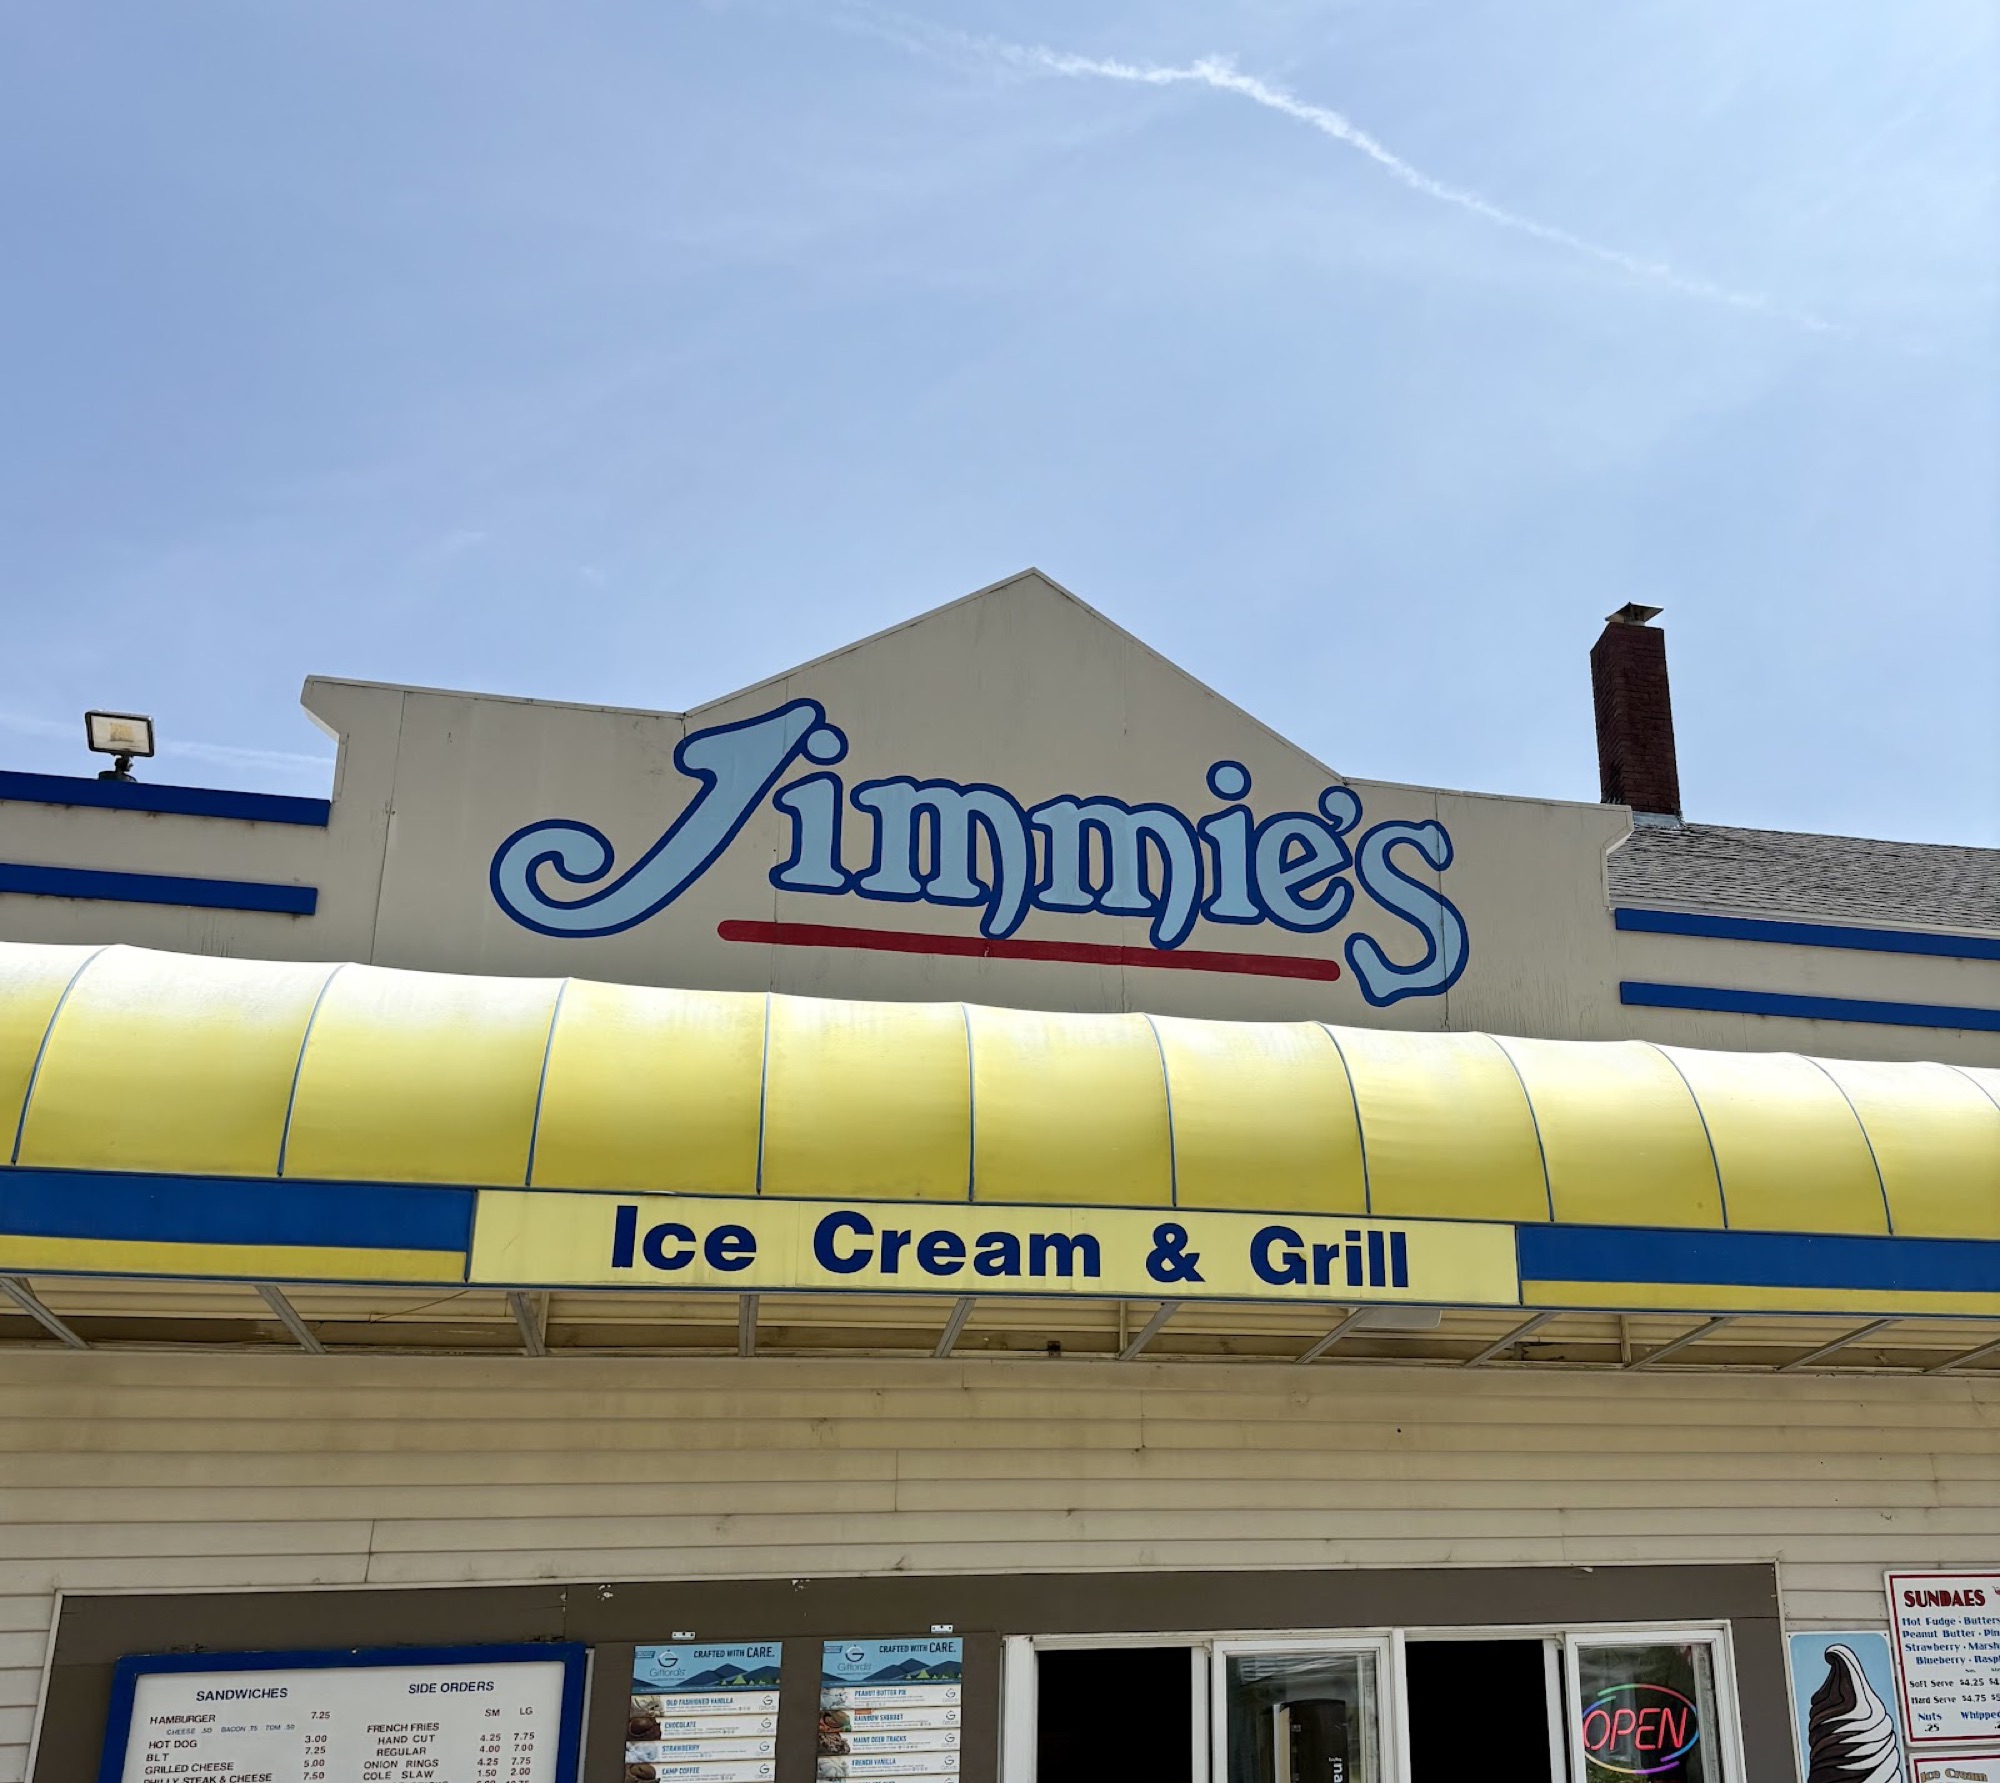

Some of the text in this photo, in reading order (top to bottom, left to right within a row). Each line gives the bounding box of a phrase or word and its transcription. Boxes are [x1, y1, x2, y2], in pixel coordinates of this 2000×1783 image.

[490, 697, 1469, 1007] Jimmie's
[611, 1205, 1409, 1288] Ice Cream & Grill
[1904, 1589, 1986, 1608] SUNDAES
[1902, 1618, 1921, 1626] Hot
[1925, 1617, 1956, 1627] Fudge
[1902, 1630, 1938, 1638] Peanut
[1942, 1630, 1975, 1638] Butter
[693, 1646, 775, 1658] CRAFTED WITH CARE.
[879, 1641, 956, 1653] CRAFTED WITH CARE.
[1905, 1643, 1960, 1652] Strawberry
[1916, 1656, 1966, 1666] Blueberry
[408, 1681, 495, 1694] SIDE ORDERS
[1909, 1680, 1928, 1688] Soft
[1930, 1679, 1954, 1688] Serve
[1959, 1677, 1985, 1687] $4.25
[195, 1687, 289, 1702] SANDWICHES
[1910, 1696, 1931, 1705] Hard
[1933, 1695, 1957, 1704] Serve
[1961, 1694, 1987, 1702] $4.75
[149, 1711, 331, 1725] HAMBURGER 7.25
[484, 1706, 534, 1718] SM LG
[1918, 1712, 1943, 1721] Nuts
[166, 1727, 196, 1736] CHEESE
[220, 1725, 246, 1733] BACON
[366, 1722, 440, 1733] FRENCH FRIES
[664, 1720, 696, 1729] CHOCOLATE
[1582, 1707, 1688, 1751] OPEN
[1924, 1723, 1940, 1732] .25
[148, 1734, 328, 1750] HOT DOG 3.00
[378, 1731, 535, 1745] HAND CUT 4.25 7.75
[305, 1746, 326, 1755] 7.25
[376, 1743, 534, 1757] REGULAR 4.00 7.00
[144, 1759, 326, 1776] GRILLED CHEESE 5.00
[363, 1756, 531, 1770] ONION RINGS 4.25 7.75
[229, 1773, 272, 1783] CHEESE
[303, 1771, 325, 1781] 7.50
[363, 1767, 531, 1781] COLE SLAW 1.50 2.00
[1920, 1767, 1988, 1783] Ice Cream
